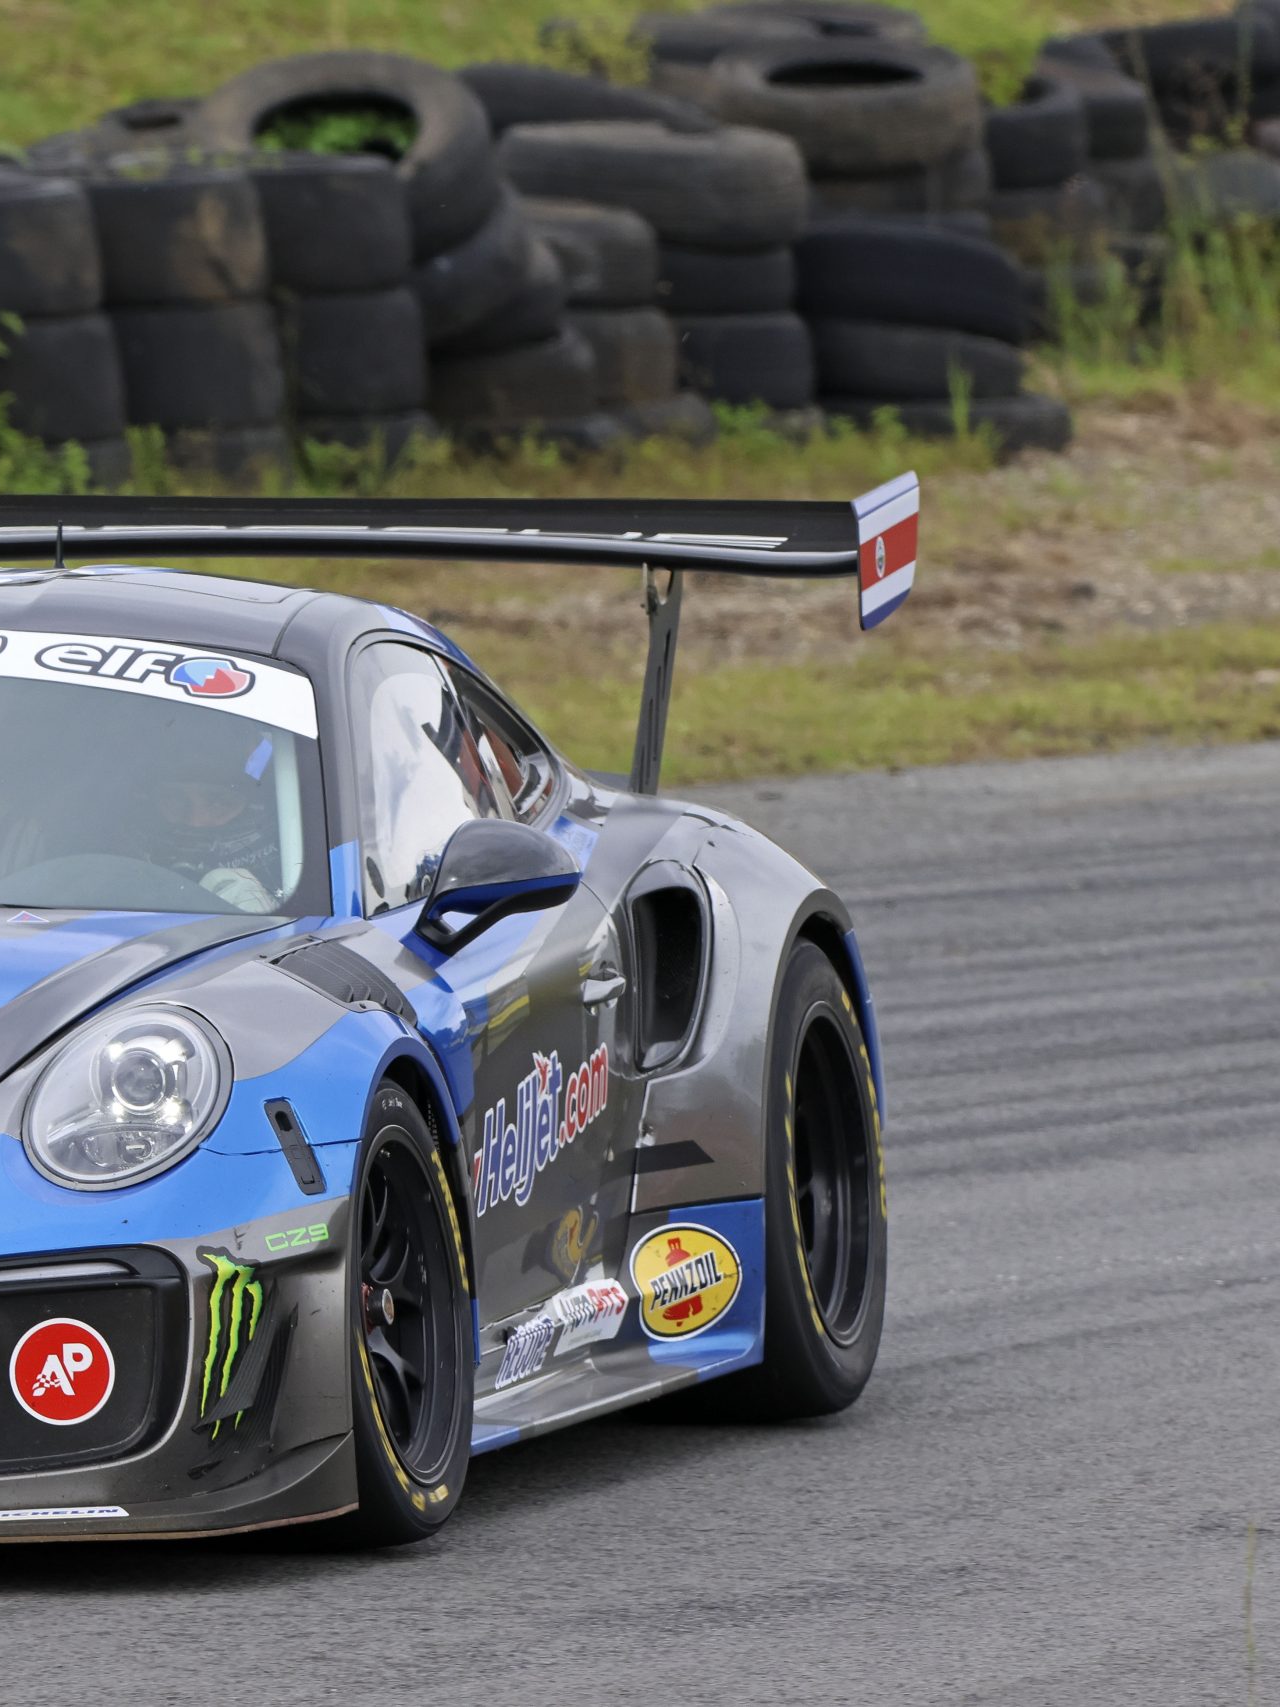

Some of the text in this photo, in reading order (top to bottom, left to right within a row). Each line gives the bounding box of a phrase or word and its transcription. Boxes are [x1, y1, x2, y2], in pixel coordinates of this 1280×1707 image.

[34, 642, 180, 684] elf
[265, 1223, 329, 1251] CZ9
[649, 1250, 724, 1313] PENNZOIL
[32, 1342, 94, 1397] AP
